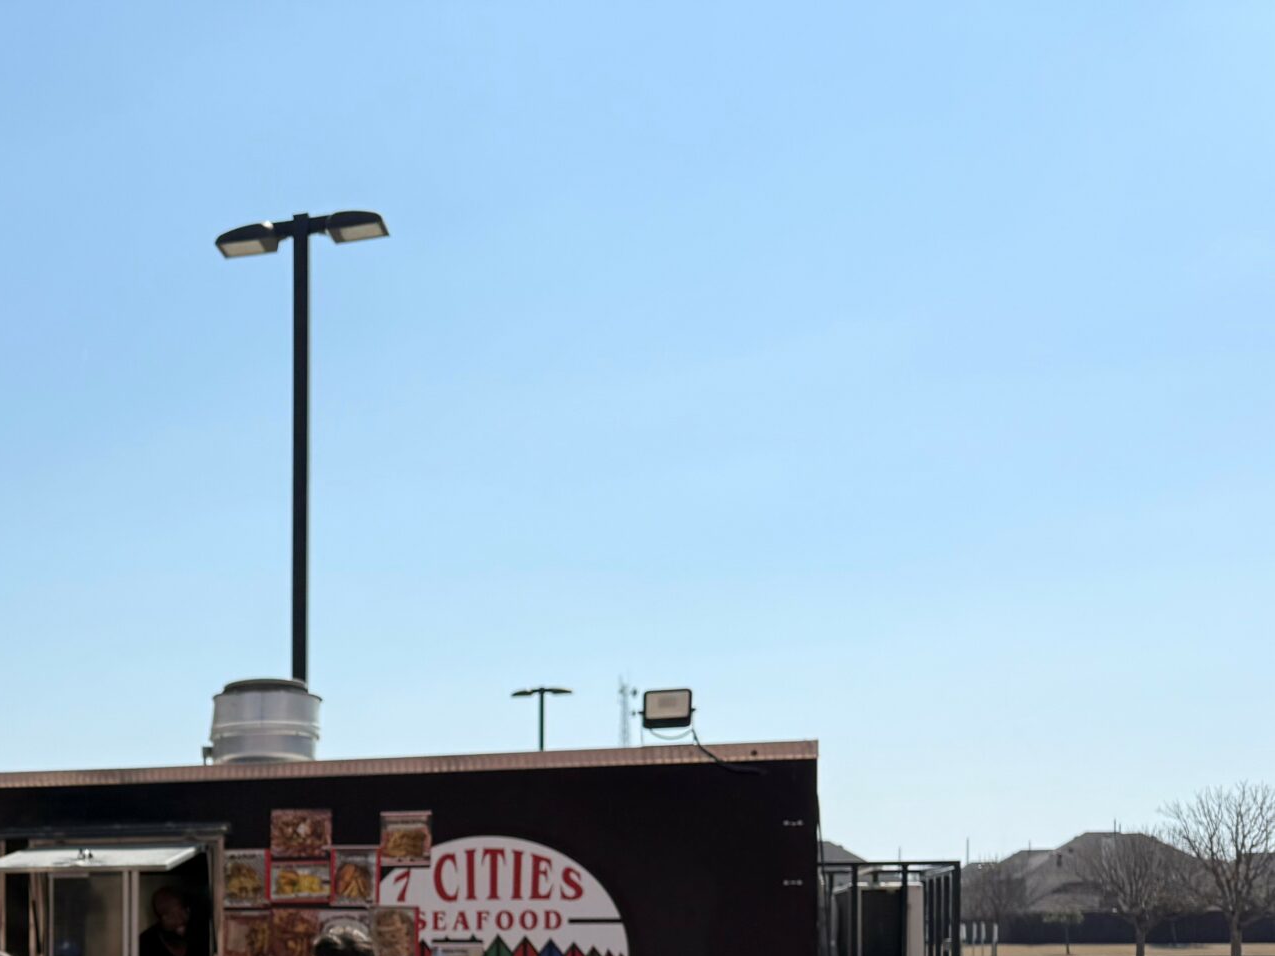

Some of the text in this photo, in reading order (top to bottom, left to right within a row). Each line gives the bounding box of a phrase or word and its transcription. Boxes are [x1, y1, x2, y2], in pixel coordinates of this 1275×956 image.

[393, 848, 584, 902] 7 CITIES
[417, 910, 562, 931] SEAFOOD
